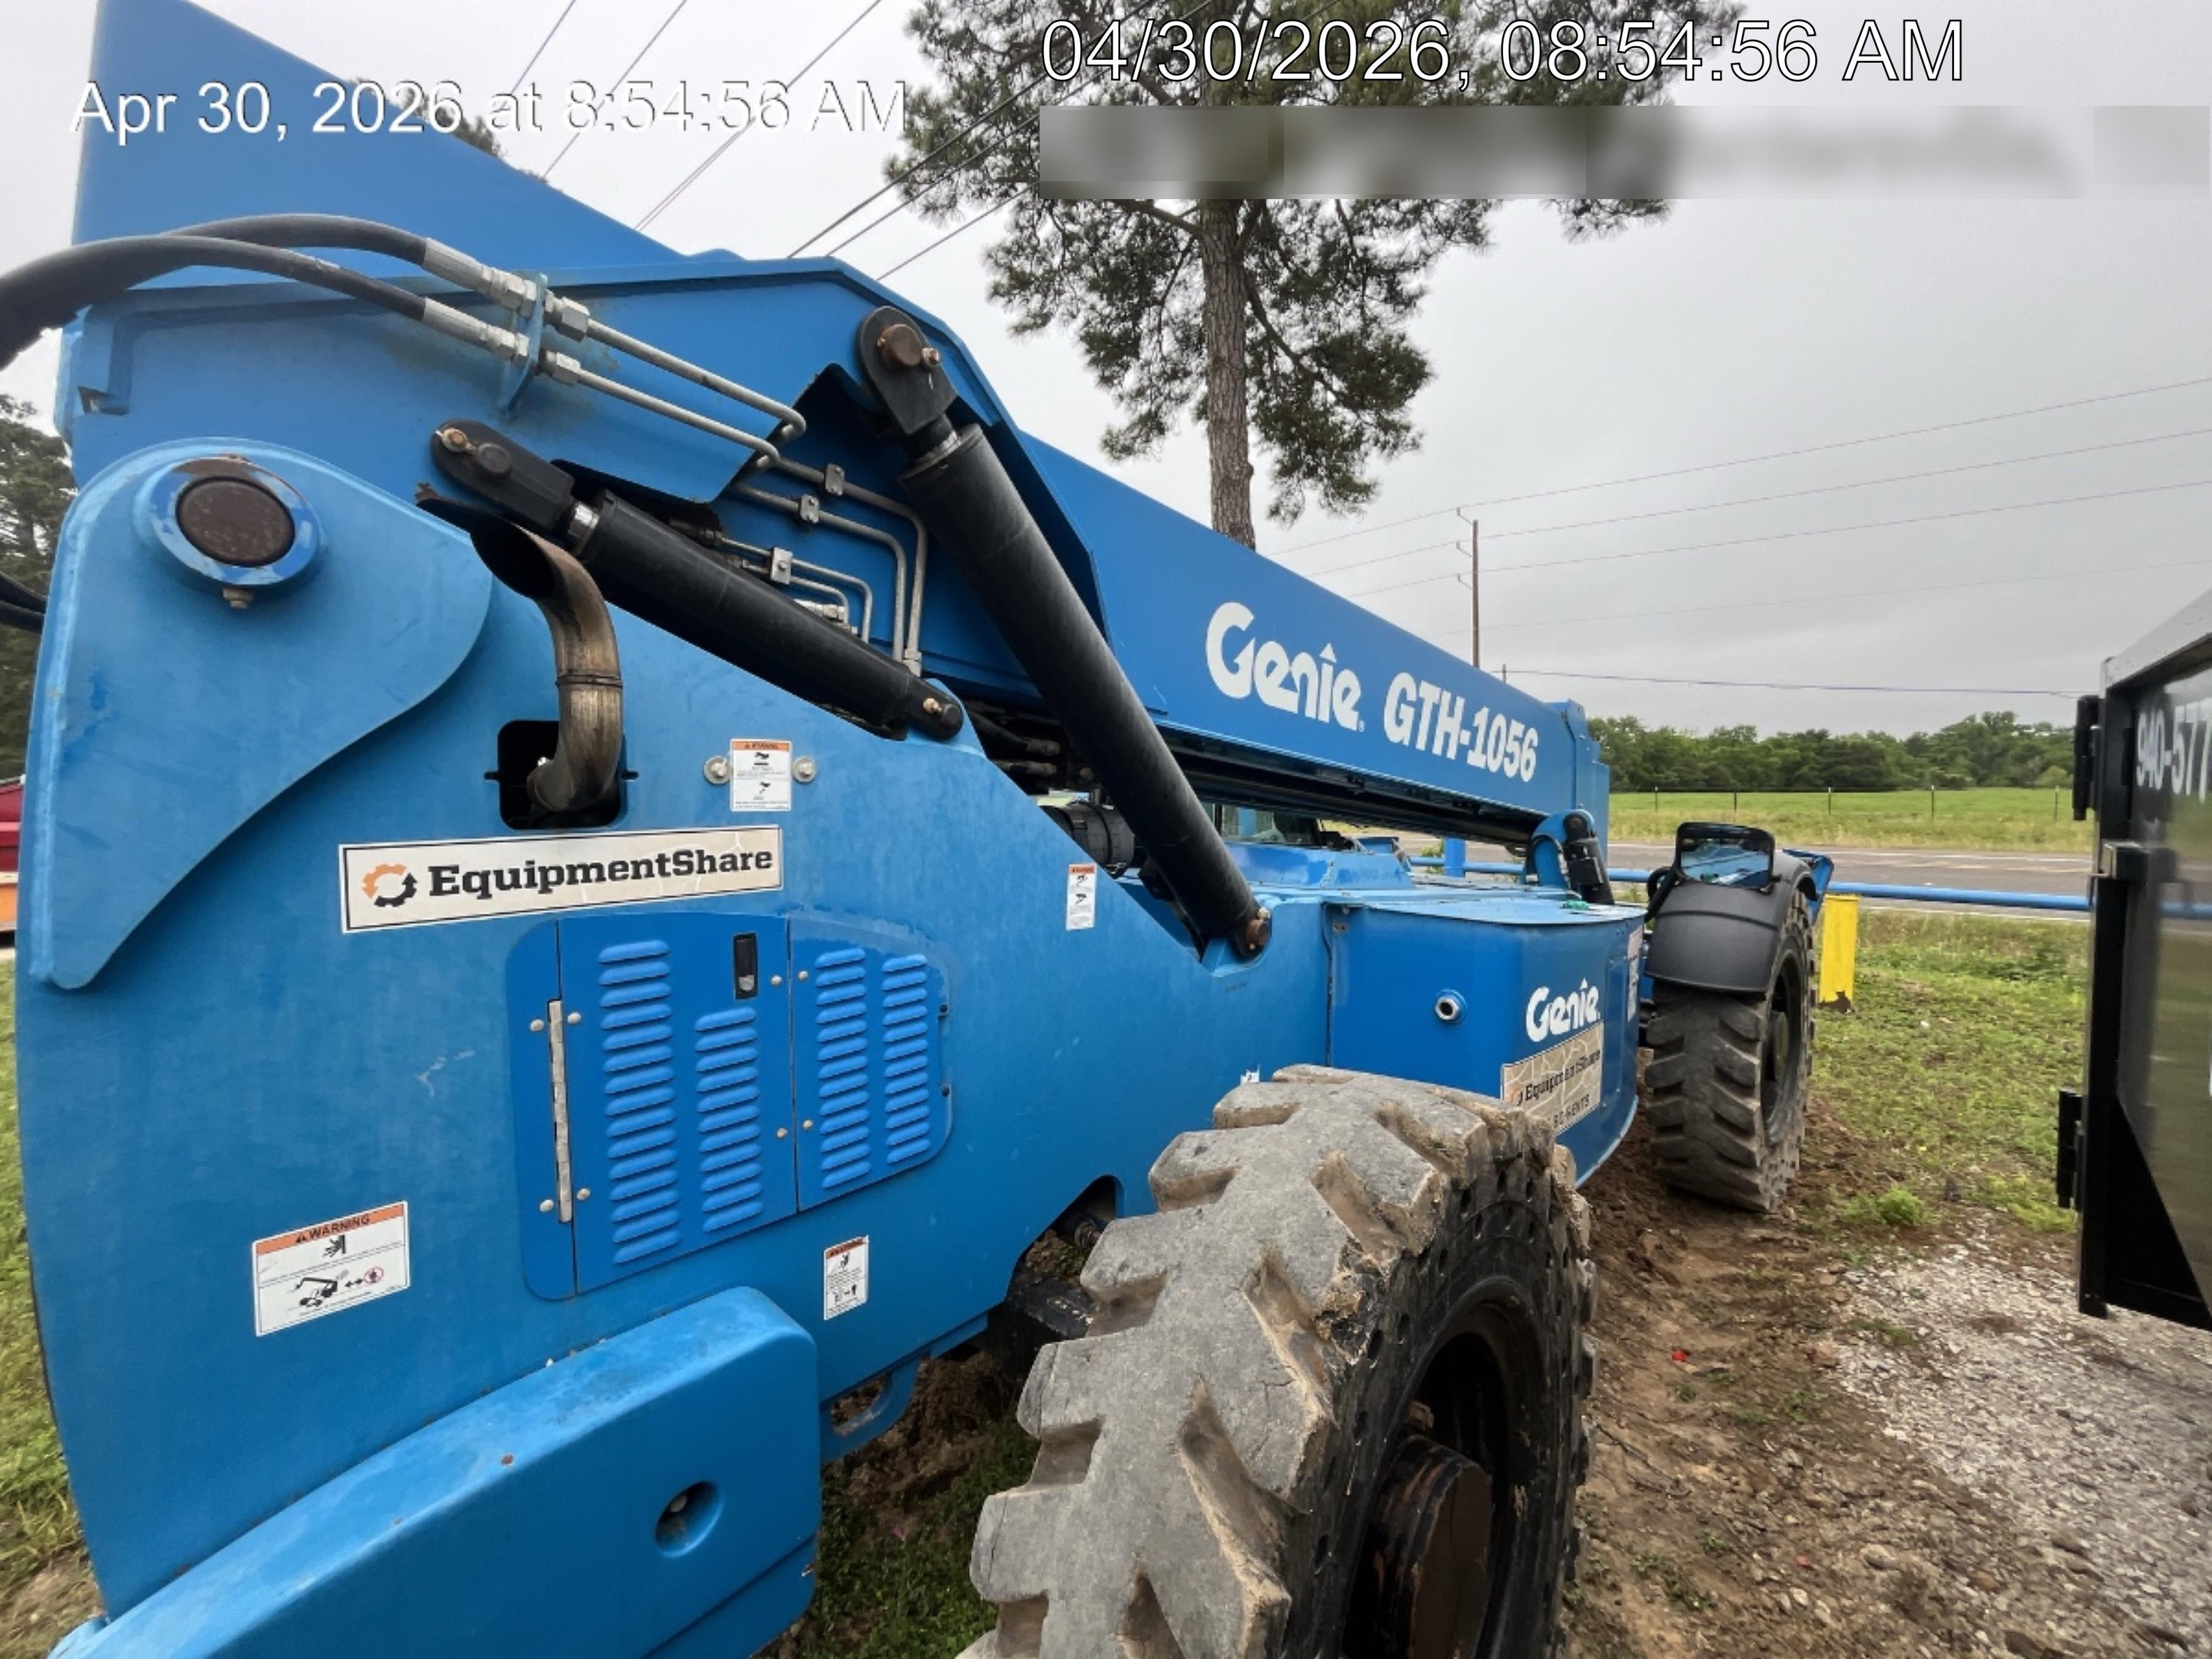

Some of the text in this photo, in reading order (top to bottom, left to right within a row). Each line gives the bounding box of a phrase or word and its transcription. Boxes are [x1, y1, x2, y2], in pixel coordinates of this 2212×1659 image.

[1206, 602, 1538, 783] Genie GTH-1056
[428, 849, 773, 900] EquipmentShare
[1526, 977, 1601, 1042] Genie
[309, 1215, 371, 1240] WARNING
